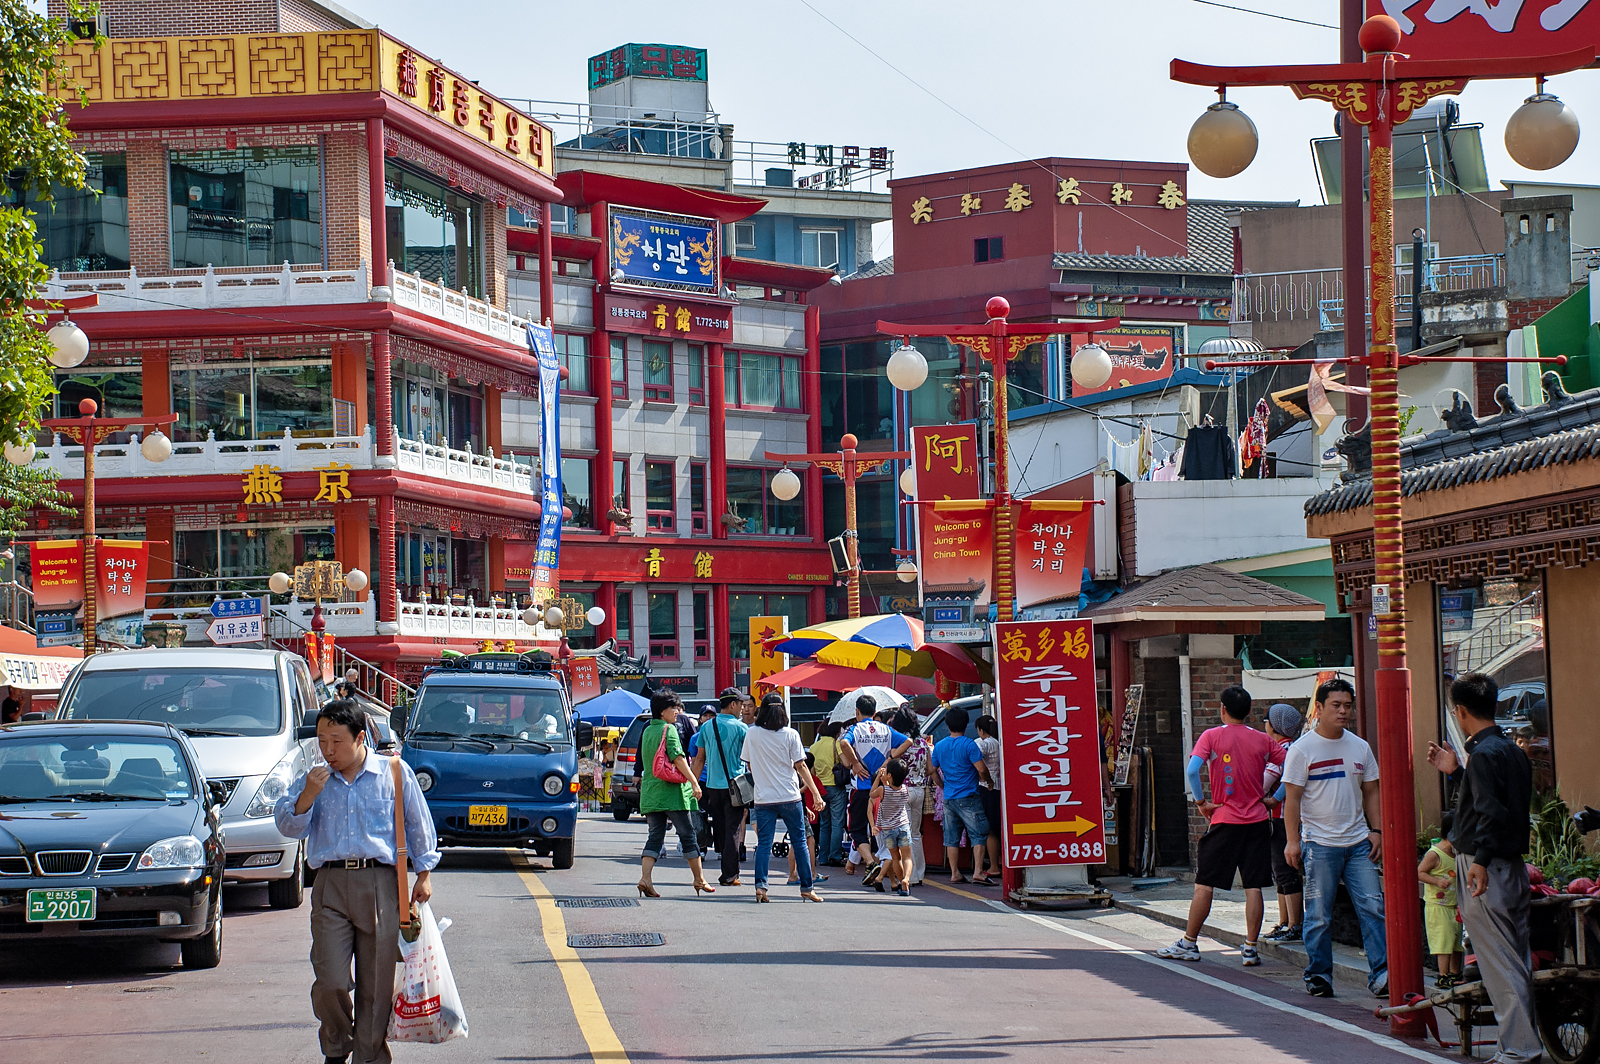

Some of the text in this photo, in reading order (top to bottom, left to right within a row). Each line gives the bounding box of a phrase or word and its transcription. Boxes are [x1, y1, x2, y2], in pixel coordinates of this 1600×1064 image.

[593, 48, 625, 86] 모텔
[642, 46, 696, 78] 모텔
[1056, 177, 1186, 210] 共和春
[910, 182, 1033, 225] 共和春
[640, 237, 691, 275] 청관
[695, 316, 730, 330] T.772-5118
[924, 433, 970, 475] 阿
[963, 465, 975, 477] 아
[241, 461, 354, 505] 燕京
[934, 521, 982, 532] Welcome to
[1030, 522, 1074, 540] 차이나
[933, 535, 968, 546] Jung-gu
[933, 548, 981, 560] China Town
[39, 557, 69, 566] Welcome
[105, 557, 137, 570] 차이나
[40, 568, 68, 576] Jung-gu
[40, 578, 78, 587] China Town
[216, 620, 259, 635] 자유공원
[1368, 616, 1377, 630] 93
[1001, 626, 1090, 663] 萬多福
[473, 661, 494, 670] 세일
[575, 665, 592, 673] 차이나
[1010, 842, 1103, 861] 773-3838
[421, 1000, 439, 1014] plus
